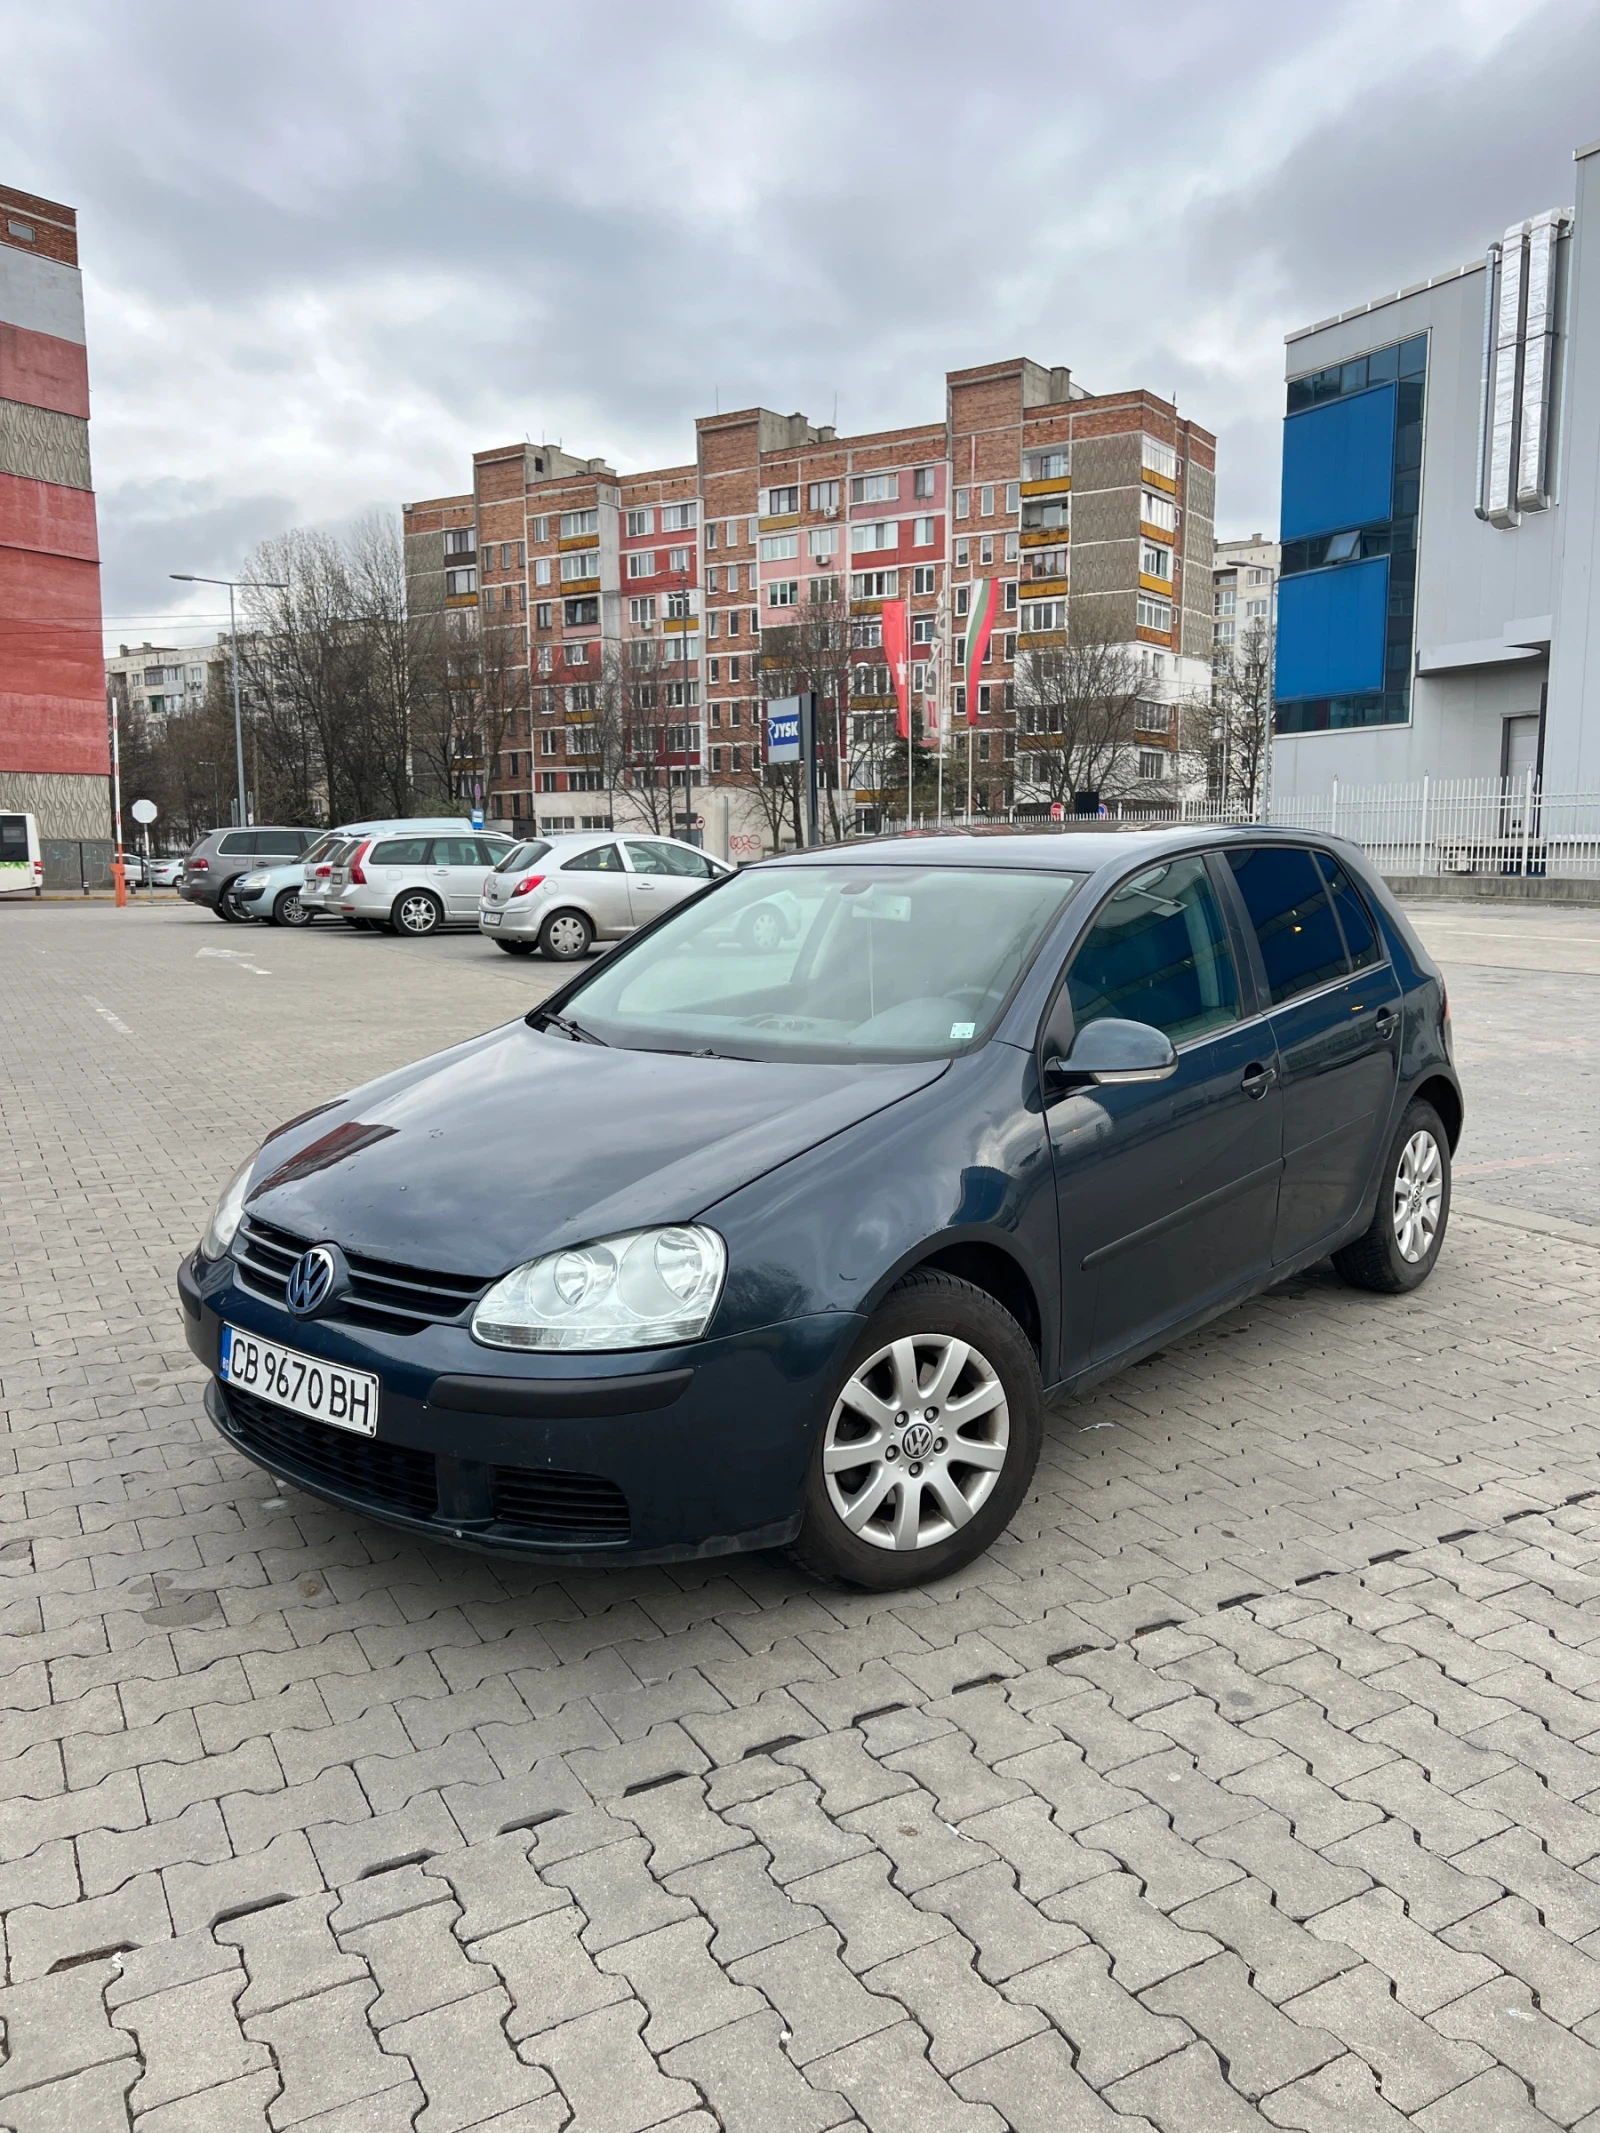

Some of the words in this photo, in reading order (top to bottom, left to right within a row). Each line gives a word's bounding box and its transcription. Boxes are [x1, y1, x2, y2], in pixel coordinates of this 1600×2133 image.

[774, 721, 798, 739] JYSK
[288, 1249, 333, 1313] VW
[232, 1338, 259, 1385] CB
[264, 1351, 324, 1410] 9670
[329, 1373, 369, 1426] BH
[905, 1426, 931, 1457] VW
